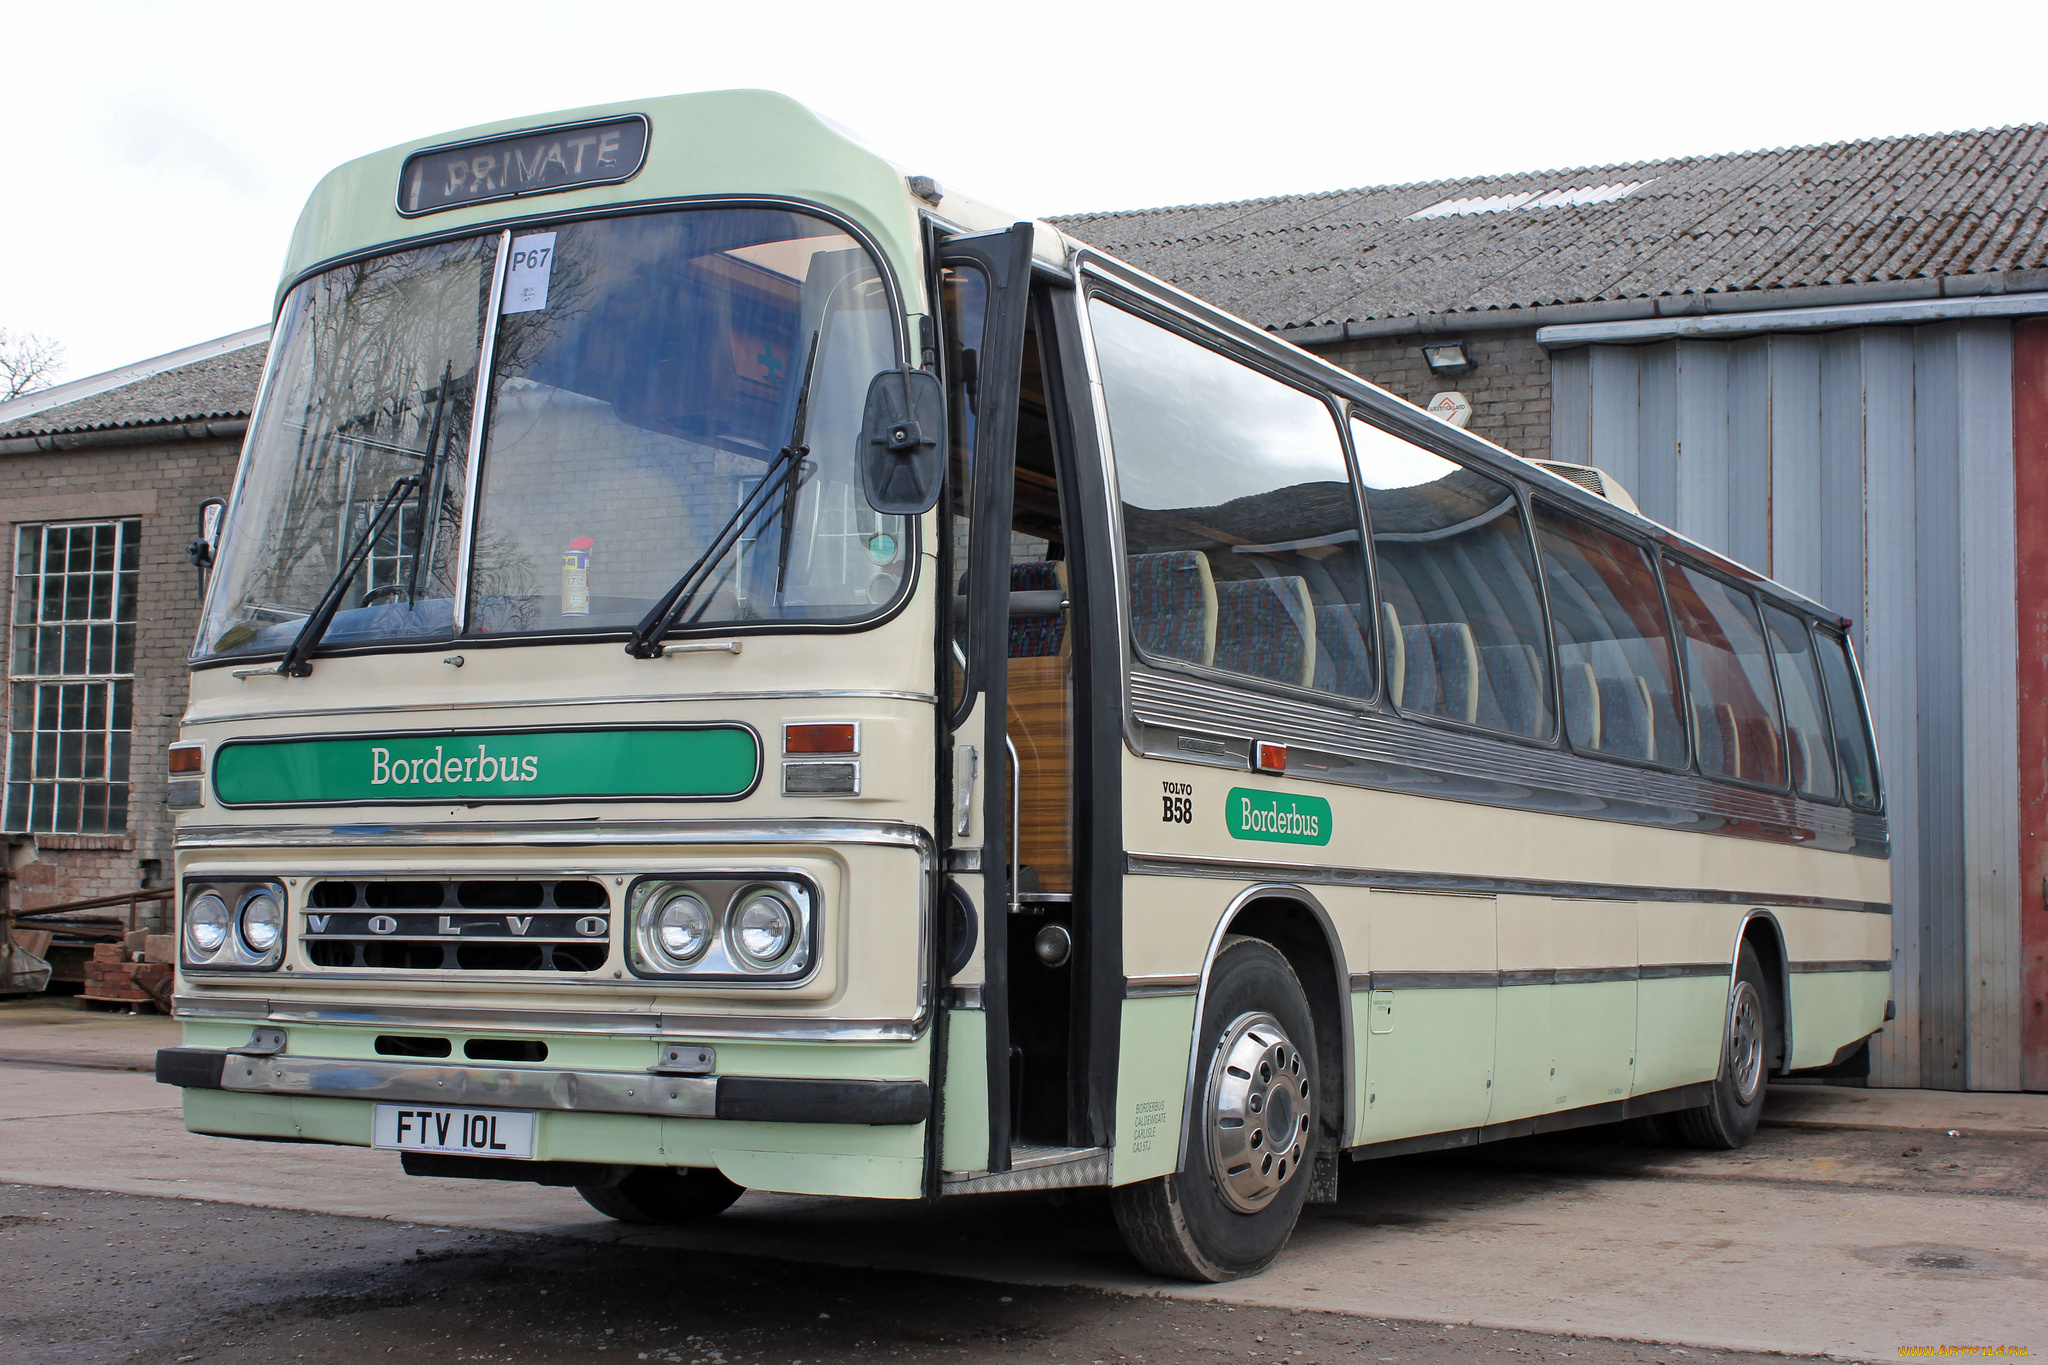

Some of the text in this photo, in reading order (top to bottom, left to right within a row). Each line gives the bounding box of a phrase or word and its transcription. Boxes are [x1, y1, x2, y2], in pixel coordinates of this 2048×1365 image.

[444, 131, 620, 196] PRIVATE
[512, 248, 551, 271] P67
[371, 744, 538, 785] Borderbus
[1162, 781, 1193, 796] VOLVO
[1162, 796, 1193, 824] B58
[1241, 797, 1319, 837] Borderbus
[308, 914, 608, 937] VOLVO
[1136, 1101, 1164, 1114] BORDERBUS
[397, 1111, 451, 1145] FTV
[1134, 1127, 1155, 1140] CARLISLE
